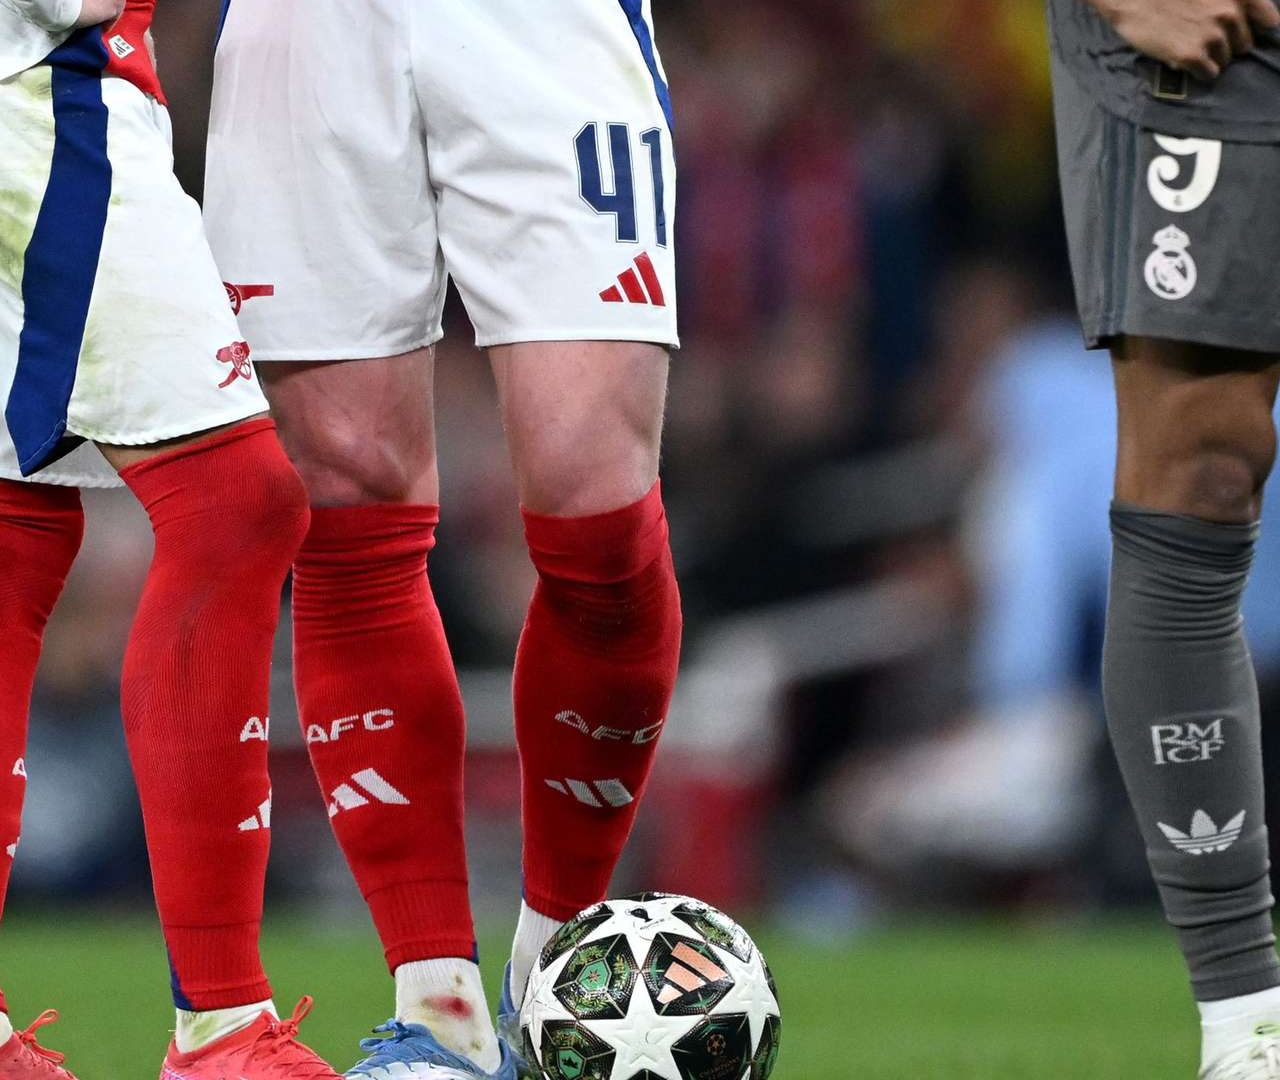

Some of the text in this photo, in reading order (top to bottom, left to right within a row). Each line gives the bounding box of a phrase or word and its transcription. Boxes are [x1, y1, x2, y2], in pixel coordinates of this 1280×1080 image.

[573, 121, 667, 249] 41
[1146, 133, 1222, 213] 9
[306, 708, 394, 744] AFC
[555, 710, 663, 745] AFC
